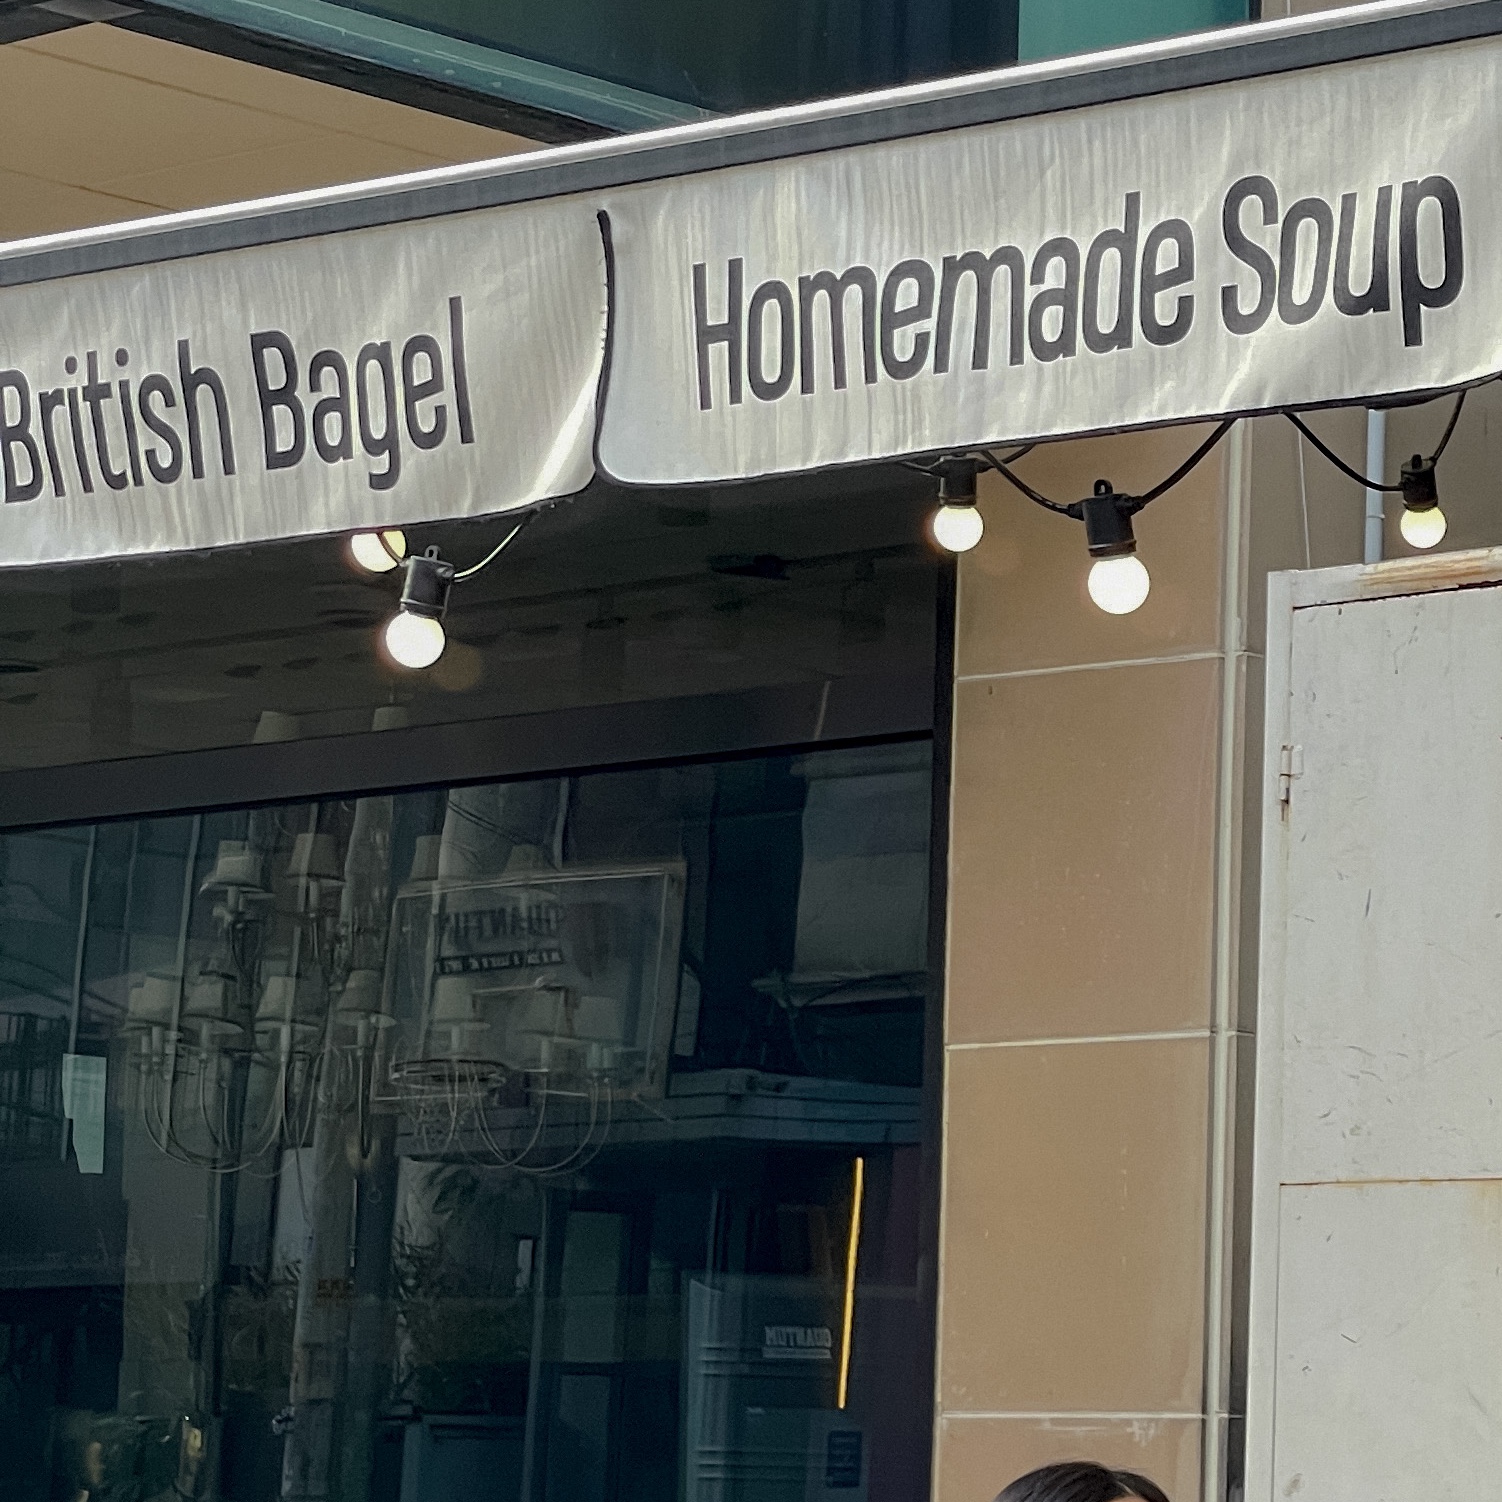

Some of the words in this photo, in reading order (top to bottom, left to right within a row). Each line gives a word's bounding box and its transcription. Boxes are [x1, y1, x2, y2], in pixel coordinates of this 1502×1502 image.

[0, 339, 236, 504] British
[250, 295, 475, 491] Bagel
[692, 191, 1194, 411] Homemade
[1221, 175, 1464, 348] Soup
